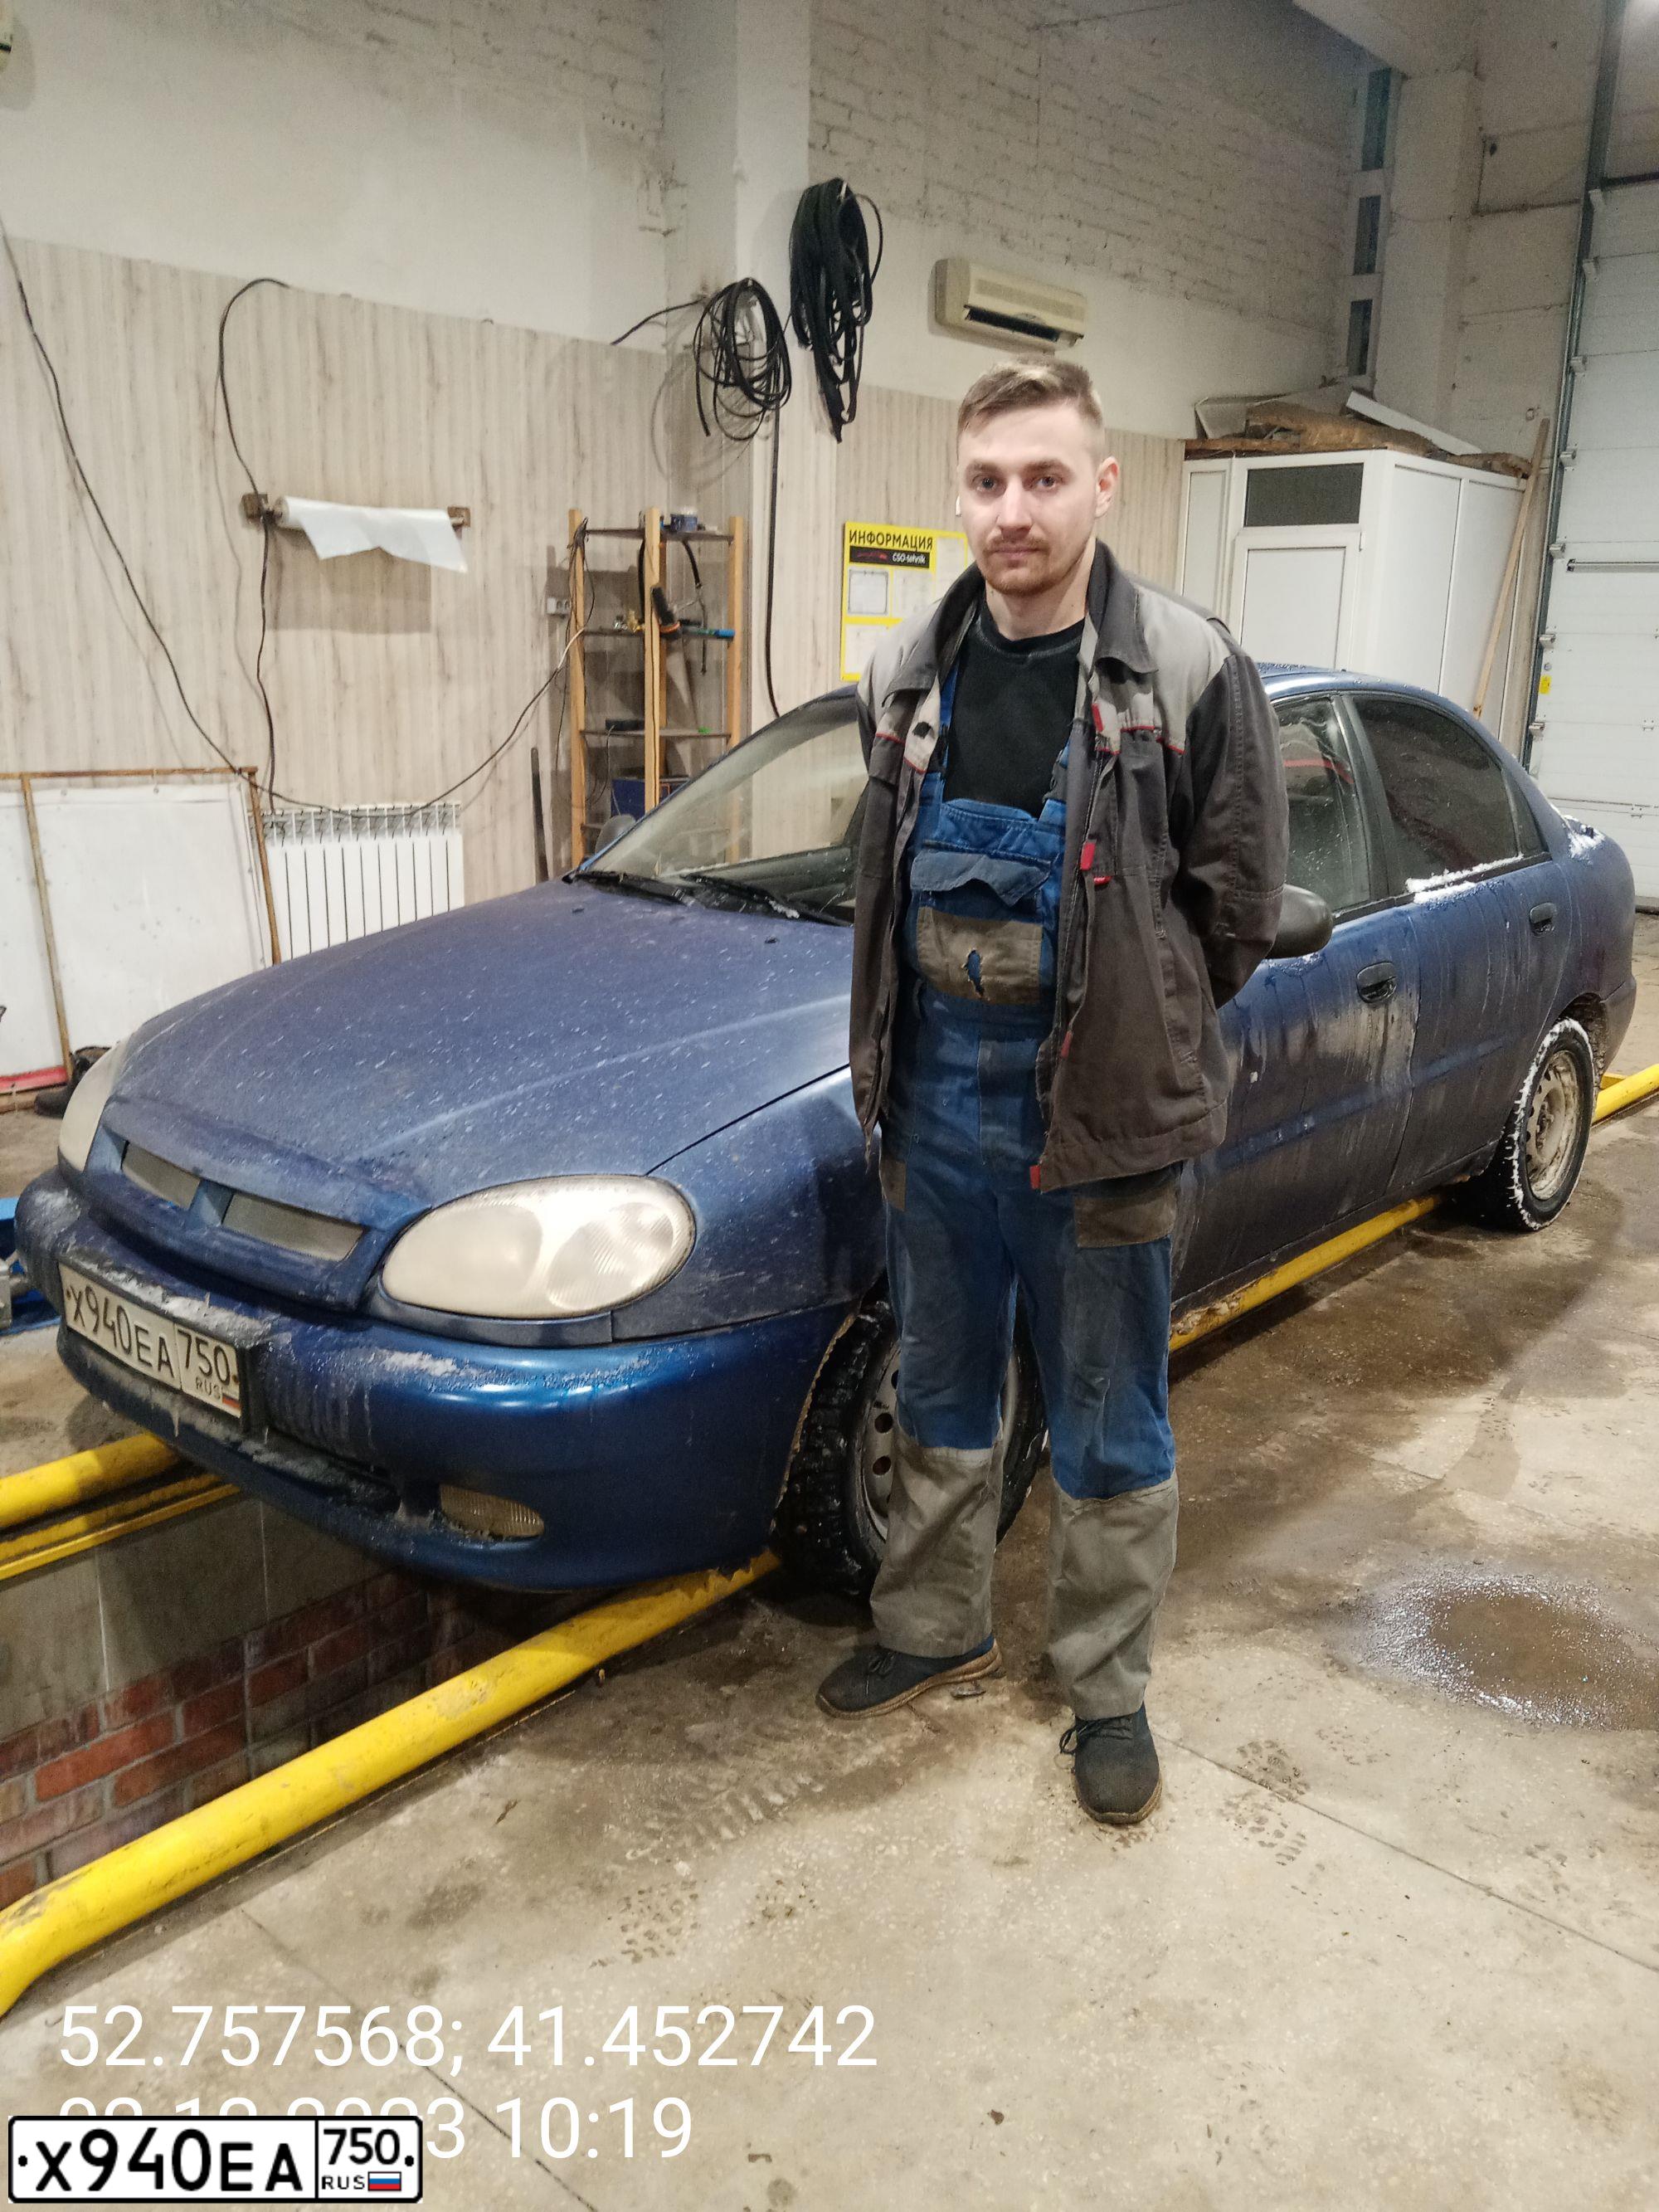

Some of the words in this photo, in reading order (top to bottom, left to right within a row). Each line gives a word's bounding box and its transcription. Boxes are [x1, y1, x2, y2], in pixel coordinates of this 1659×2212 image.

[849, 530, 932, 551] ИНФОРМАЦИЯ
[178, 1328, 231, 1386] 750
[196, 1376, 222, 1401] RUS
